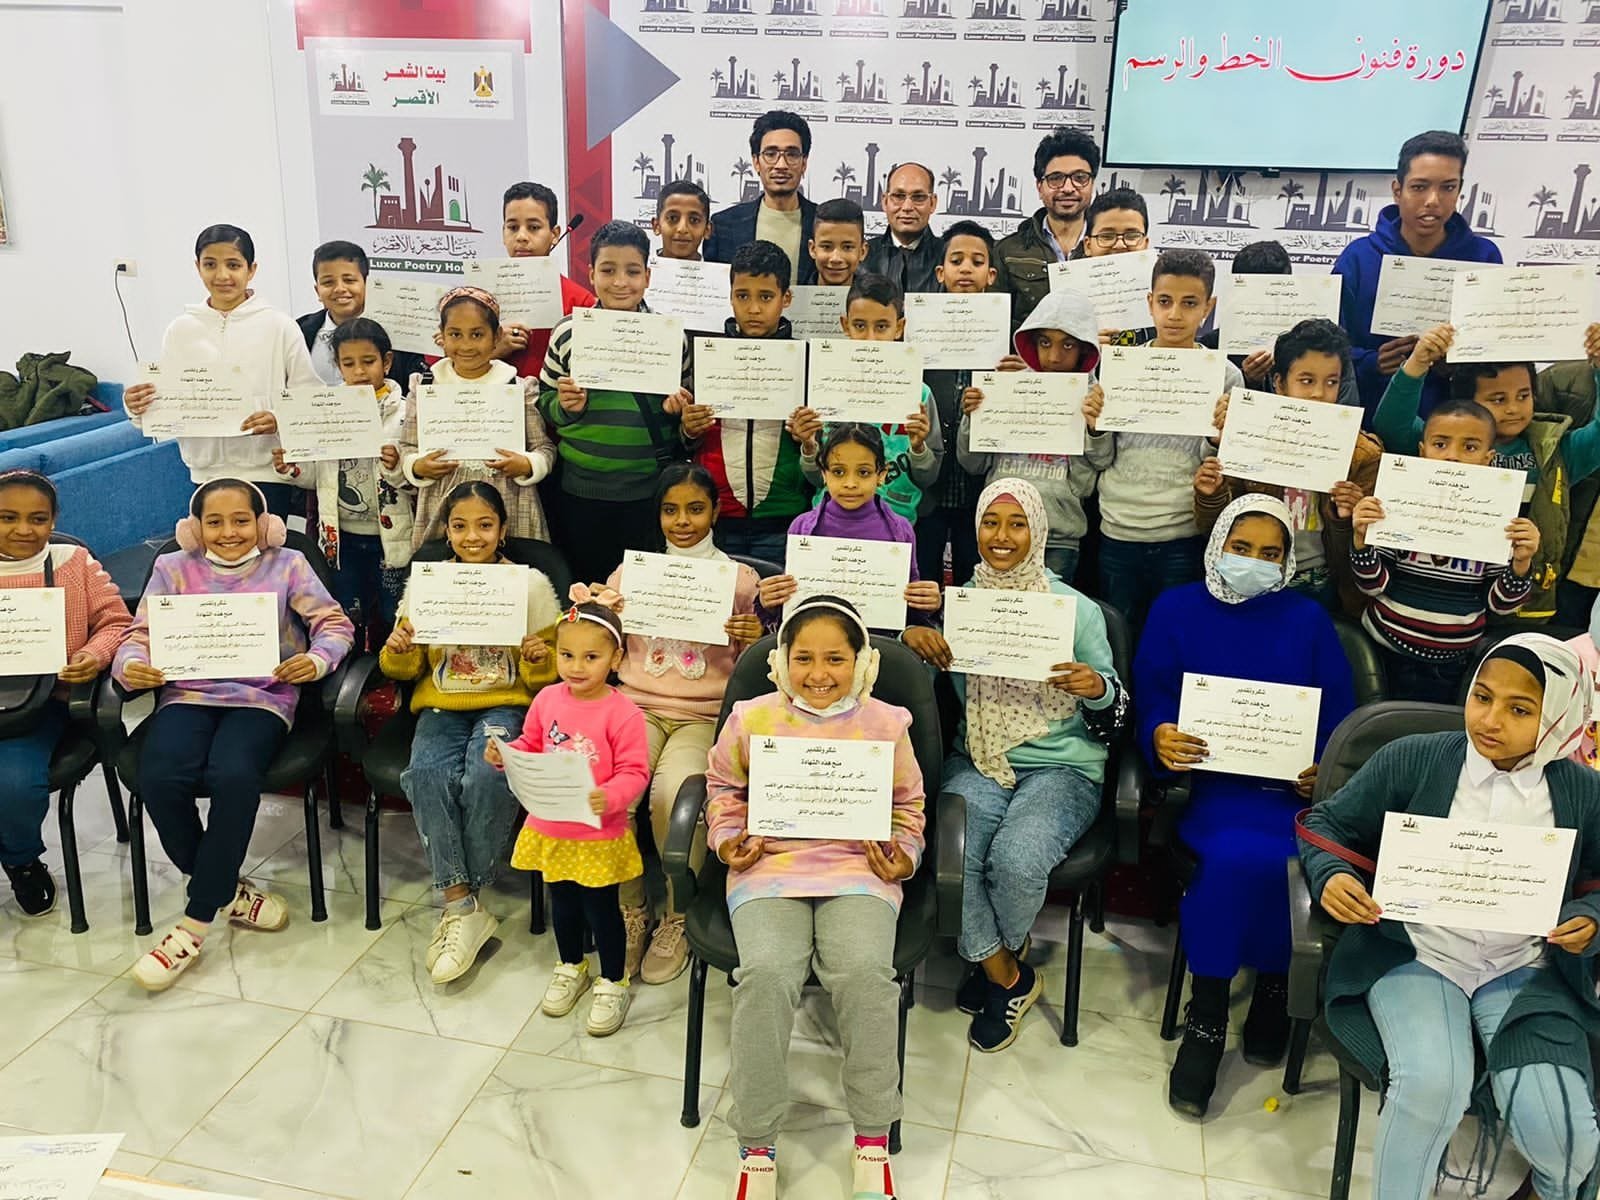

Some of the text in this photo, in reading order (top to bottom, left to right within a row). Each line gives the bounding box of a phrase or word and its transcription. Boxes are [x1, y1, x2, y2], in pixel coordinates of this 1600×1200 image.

[1123, 32, 1466, 91] دورة فنون الخط والرسم
[384, 63, 447, 83] بيت الشعر
[392, 90, 440, 107] الأقصر
[369, 259, 401, 269] Luxor
[405, 261, 441, 272] Poetry
[1303, 255, 1336, 265] Poetry
